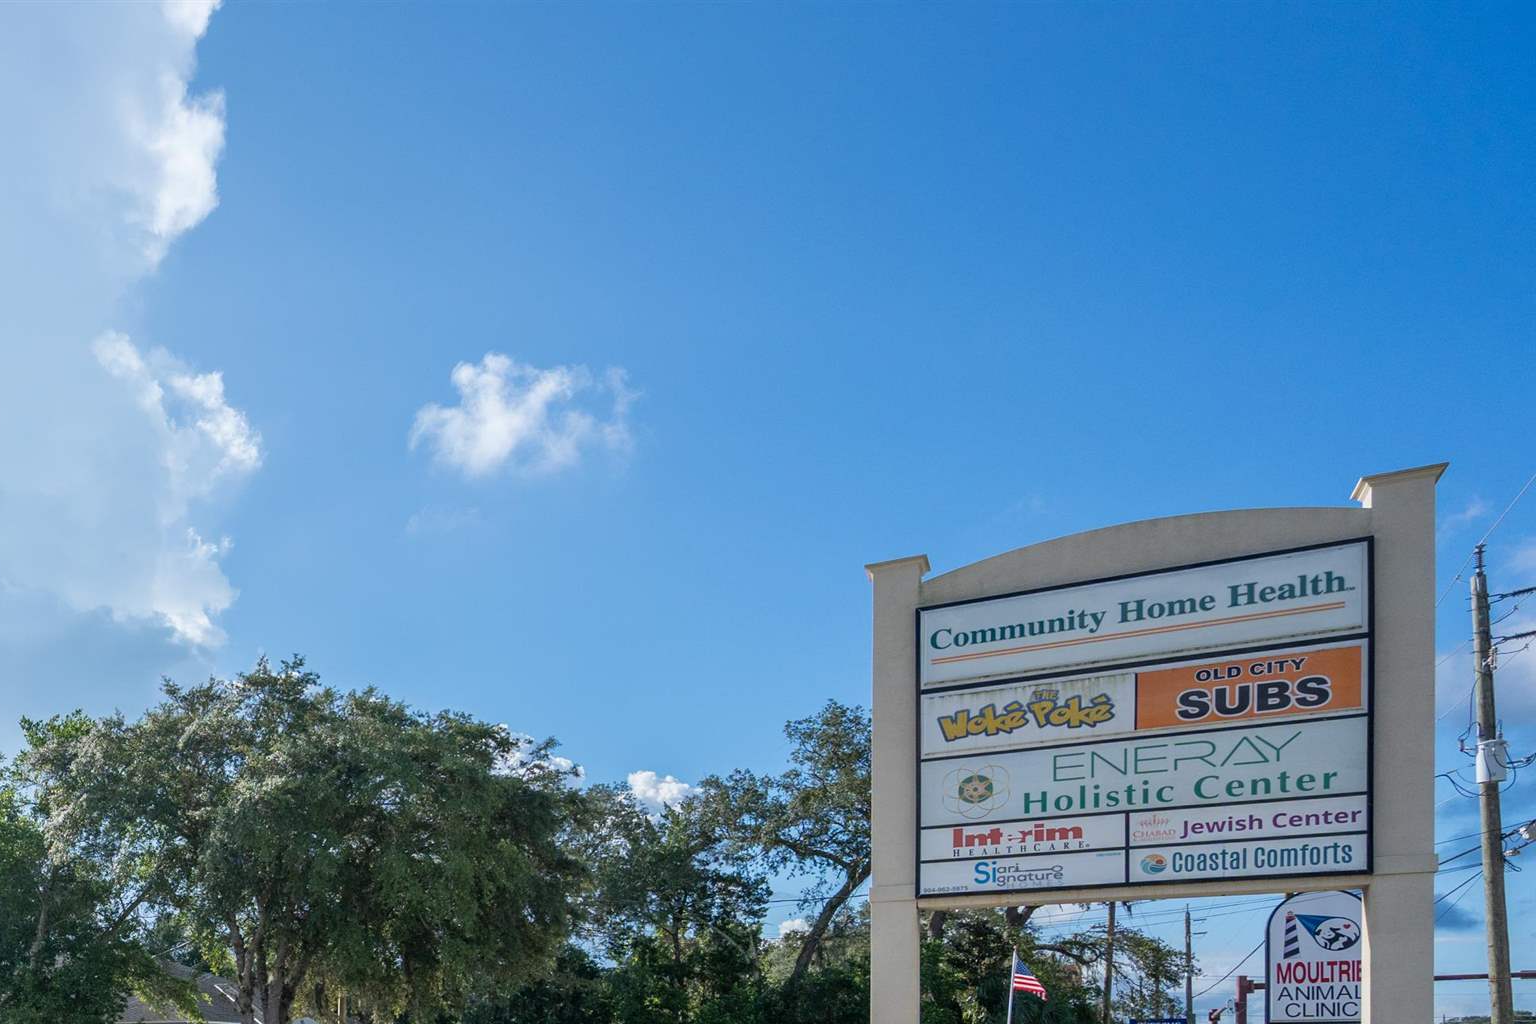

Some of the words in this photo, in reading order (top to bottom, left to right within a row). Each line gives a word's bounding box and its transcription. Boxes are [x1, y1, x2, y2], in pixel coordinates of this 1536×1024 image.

[930, 609, 1107, 650] Community
[1118, 594, 1215, 624] Home
[1227, 570, 1346, 608] Health
[1195, 665, 1242, 682] OLD
[1249, 656, 1307, 676] CITY
[1027, 693, 1116, 729] Poké
[1031, 689, 1059, 701] THE
[1175, 674, 1333, 721] SUBS
[1052, 731, 1302, 782] ENERAY
[1023, 780, 1175, 814] Holistic
[1193, 771, 1338, 800] Center
[1180, 814, 1264, 839] Jewish
[1272, 809, 1363, 829] Center
[1172, 847, 1248, 874] Coastal
[1254, 842, 1353, 870] Comforts
[1285, 1001, 1359, 1018] CLINIC
